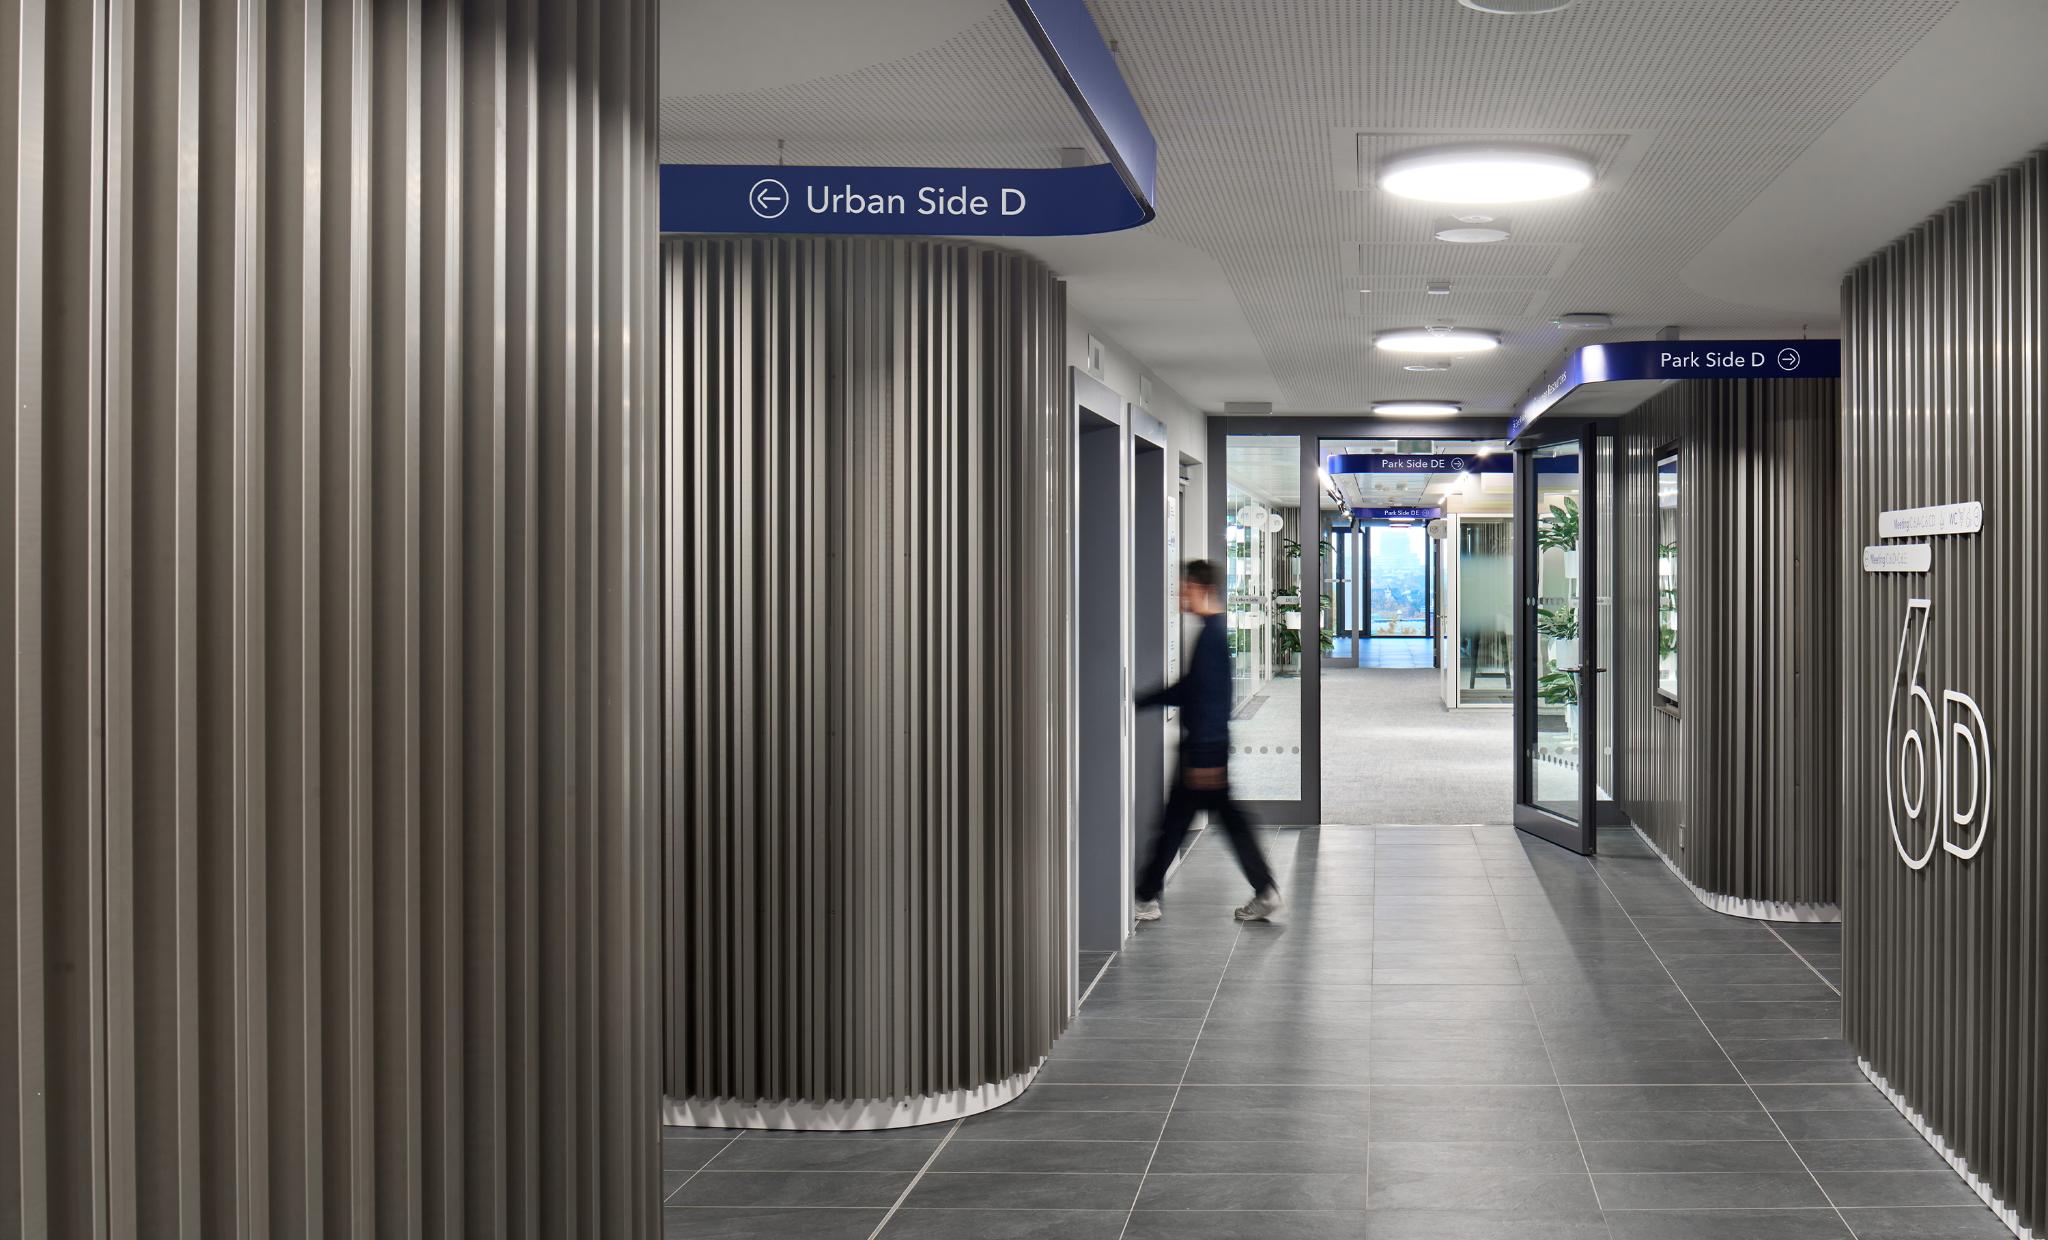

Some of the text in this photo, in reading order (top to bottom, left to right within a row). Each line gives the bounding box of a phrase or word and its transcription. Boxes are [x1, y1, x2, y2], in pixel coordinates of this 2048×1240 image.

[807, 185, 1026, 216] Urban Side D
[1661, 351, 1765, 368] Park Side D
[1382, 459, 1445, 468] Park Side DE
[1886, 598, 1991, 870] 6D
